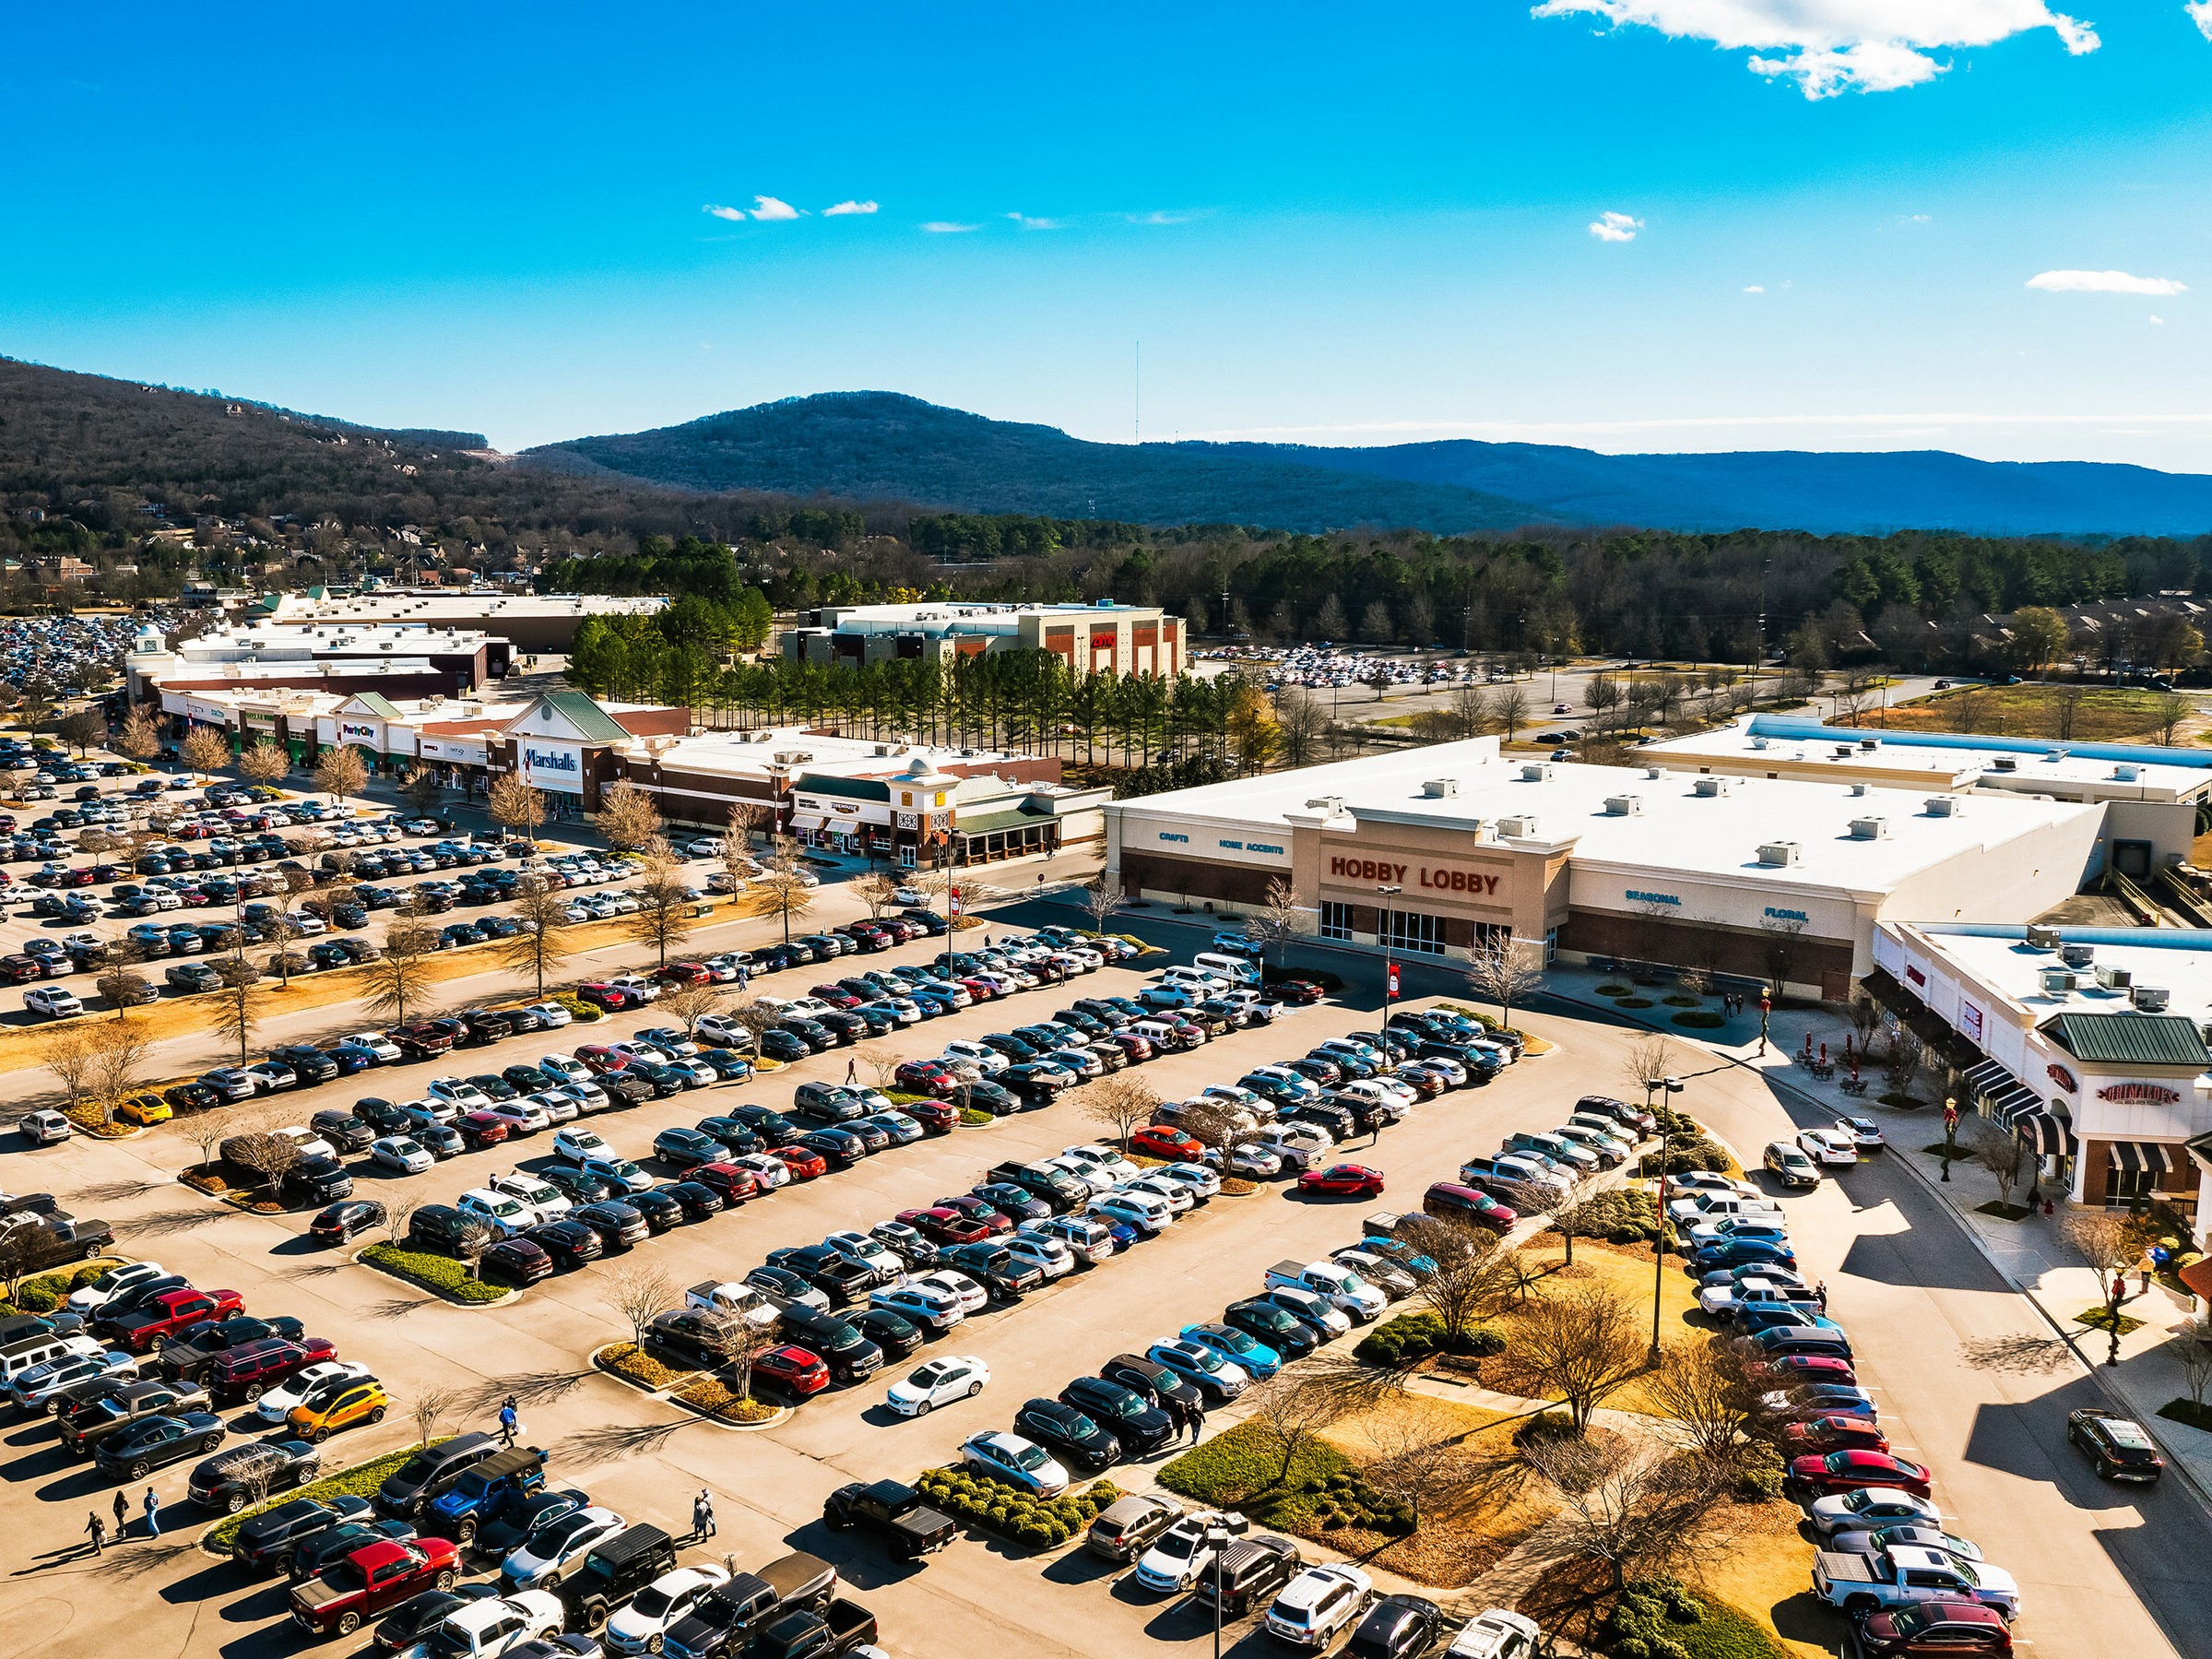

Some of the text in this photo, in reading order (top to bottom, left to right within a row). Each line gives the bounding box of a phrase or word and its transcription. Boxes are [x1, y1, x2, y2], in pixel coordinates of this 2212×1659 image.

[522, 749, 577, 772] Marshalls
[1159, 832, 1189, 843] CRAFTS
[1219, 839, 1284, 855] HOME ACCENTS
[1330, 856, 1500, 895] HOBBY LOBBY
[1626, 890, 1682, 906] SEASONAL
[1764, 907, 1809, 921] FLORAL
